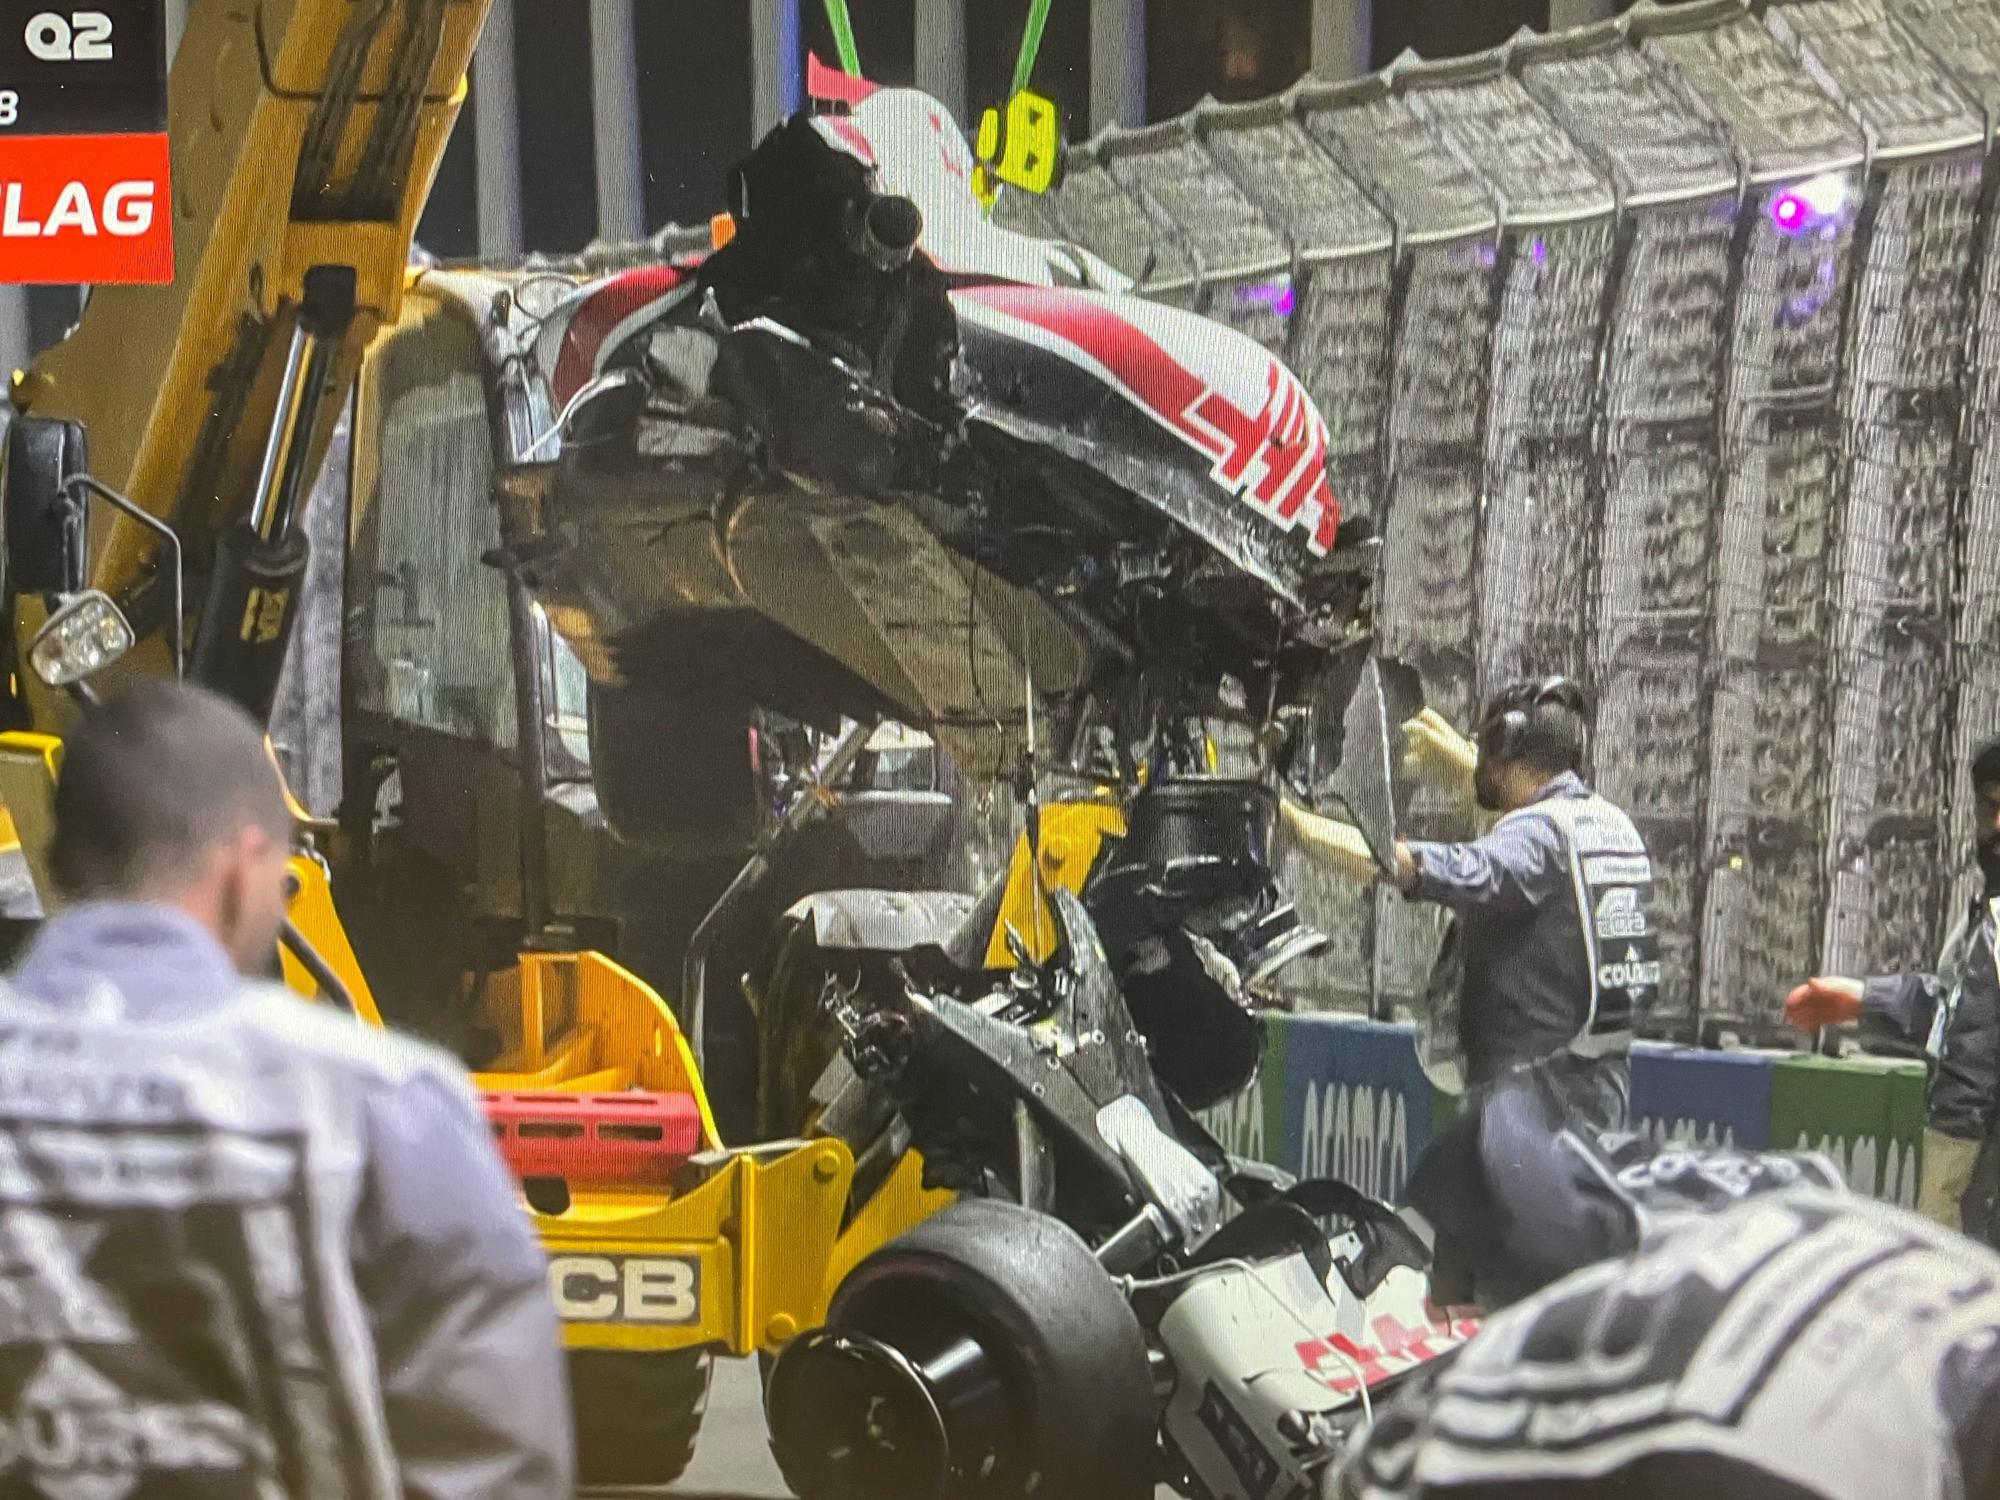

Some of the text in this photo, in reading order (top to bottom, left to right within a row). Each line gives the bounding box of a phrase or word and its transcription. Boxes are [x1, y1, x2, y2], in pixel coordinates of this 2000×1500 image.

[24, 11, 113, 61] Q2
[0, 180, 155, 237] LAG
[547, 1256, 696, 1321] CB
